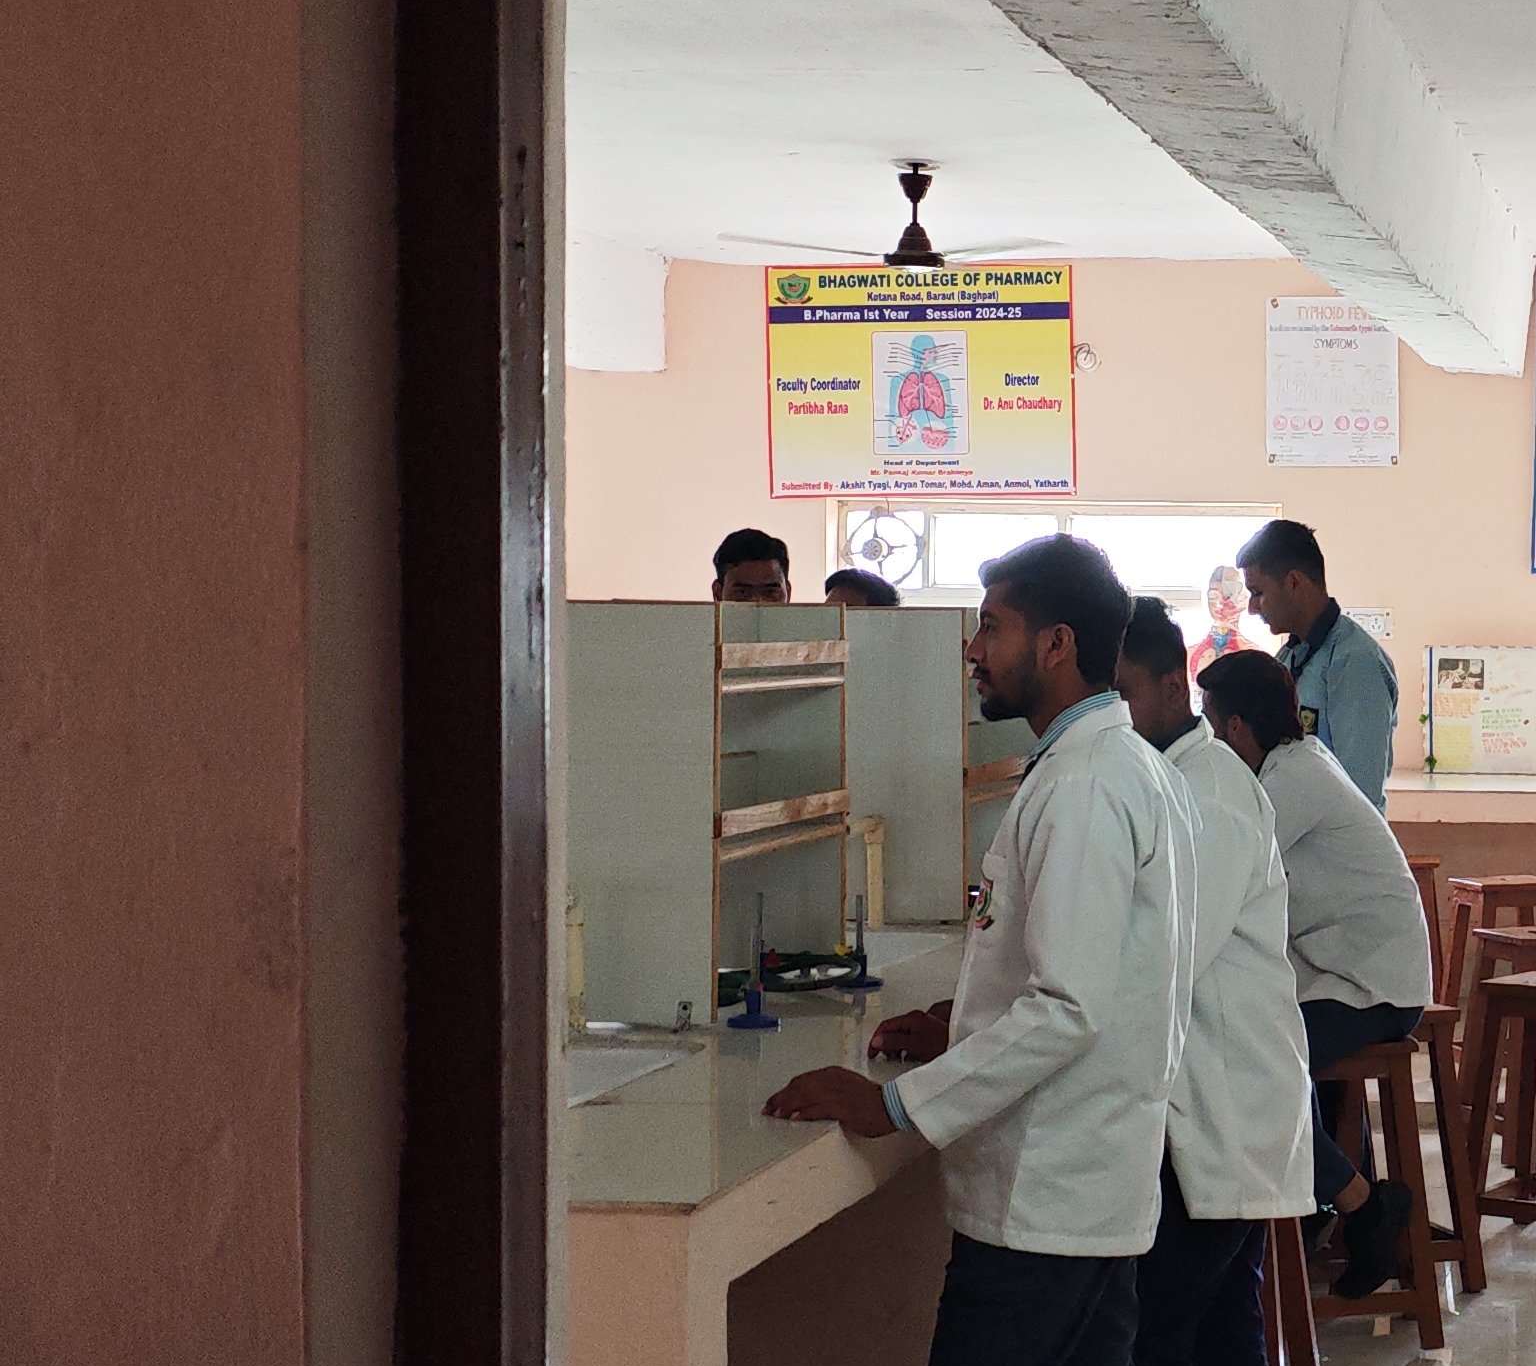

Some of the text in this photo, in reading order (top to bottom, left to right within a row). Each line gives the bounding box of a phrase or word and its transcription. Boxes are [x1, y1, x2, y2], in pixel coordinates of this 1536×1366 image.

[818, 271, 1062, 288] BHAGWATI COLLEGE OF PHARMACY
[867, 290, 998, 302] Kotana Road, Baraut (Baghpat)
[804, 309, 860, 320] B.Pharma
[883, 309, 910, 320] Year
[926, 308, 972, 319] Session
[976, 307, 1022, 319] 2024-25
[1296, 306, 1345, 320] TYPHOID
[1313, 338, 1359, 349] SYMPTOMS
[776, 377, 861, 394] Faculty Coordinator
[1004, 373, 1040, 386] Director
[788, 401, 849, 415] Partibha Rana
[983, 396, 1062, 413] Dr. Anu Chaudhary
[781, 482, 821, 491] Submitted
[823, 481, 834, 492] By
[840, 481, 866, 490] Akshit
[867, 480, 892, 491] Tyagi,
[893, 480, 918, 490] Aryan
[920, 480, 948, 490] Tomar,
[950, 480, 974, 489] Mohd.
[976, 480, 1002, 489] Aman,
[1004, 479, 1032, 489] Anmol,
[1034, 479, 1069, 488] Yatharth
